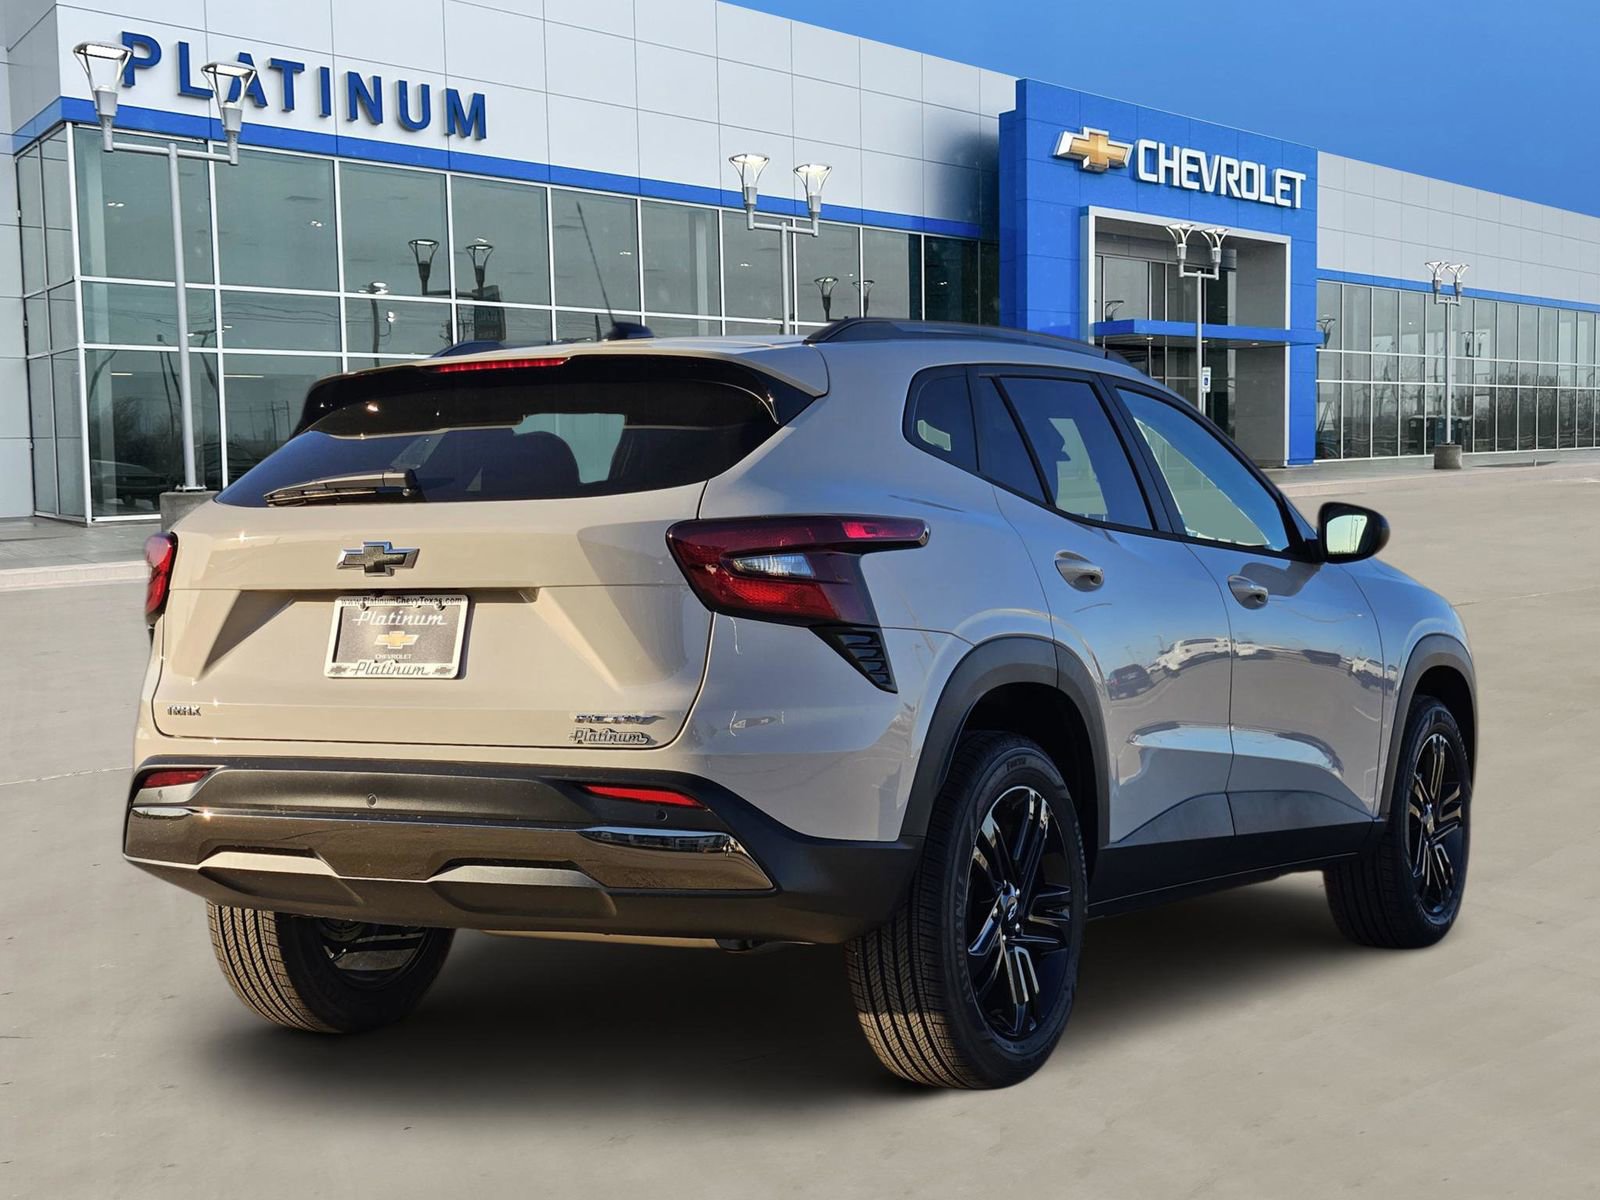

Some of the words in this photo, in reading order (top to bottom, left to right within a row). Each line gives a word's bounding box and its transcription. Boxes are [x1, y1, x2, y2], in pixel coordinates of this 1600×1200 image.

[121, 31, 487, 140] PLATINUM
[1136, 138, 1306, 209] CHEVROLET
[352, 610, 447, 626] Platinum
[350, 660, 430, 676] Platinum
[569, 728, 650, 744] Platinum
